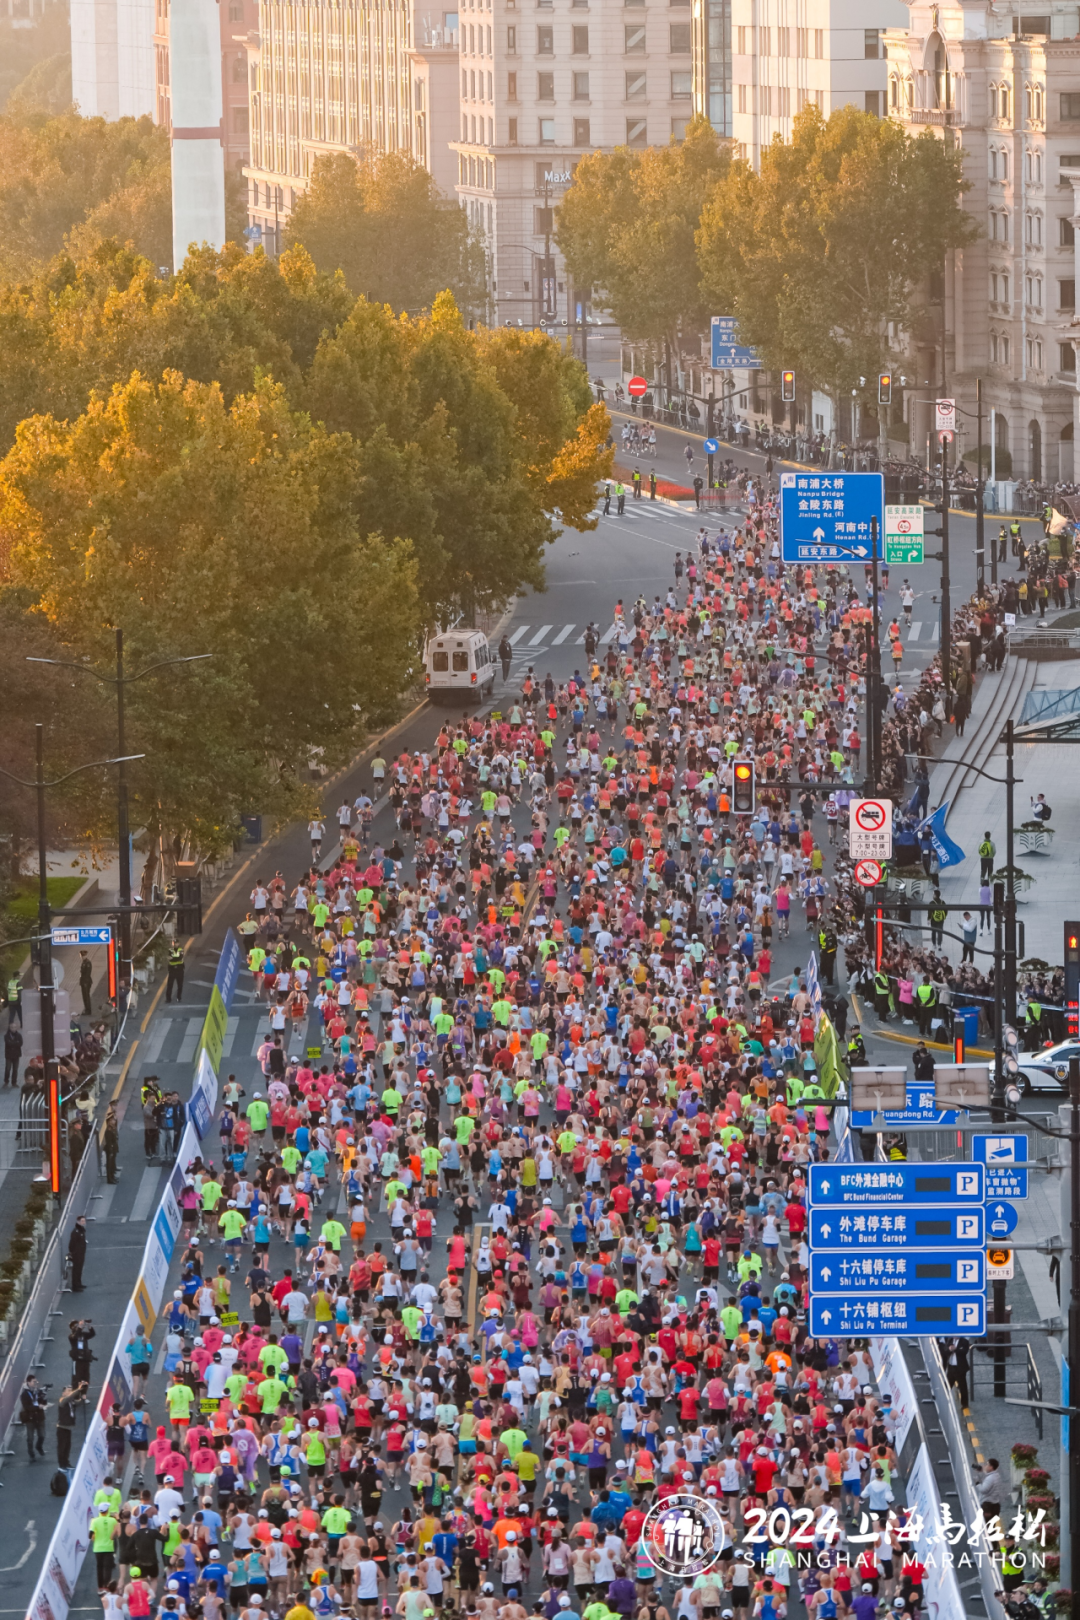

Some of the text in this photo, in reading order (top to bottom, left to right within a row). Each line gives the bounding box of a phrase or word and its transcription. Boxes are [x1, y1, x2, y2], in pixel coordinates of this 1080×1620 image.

[798, 478, 844, 489] 南浦大桥
[798, 500, 844, 510] 金陵东路
[835, 522, 880, 533] 河南中路
[801, 547, 837, 556] 延安东路
[841, 1173, 904, 1188] BFC外滩金融中心
[961, 1176, 974, 1191] P
[988, 1187, 1021, 1196] 监测路段
[839, 1215, 906, 1232] 外滩停车库
[961, 1220, 974, 1235] P
[840, 1234, 906, 1244] The Bund Garage
[839, 1259, 906, 1275] 十六铺停车库
[961, 1264, 974, 1278] P
[840, 1277, 906, 1288] Shi Liu Pu Garage
[839, 1302, 907, 1318] 十六铺枢纽
[962, 1308, 974, 1322] P
[840, 1321, 907, 1329] Shi Liu Pu Terminal
